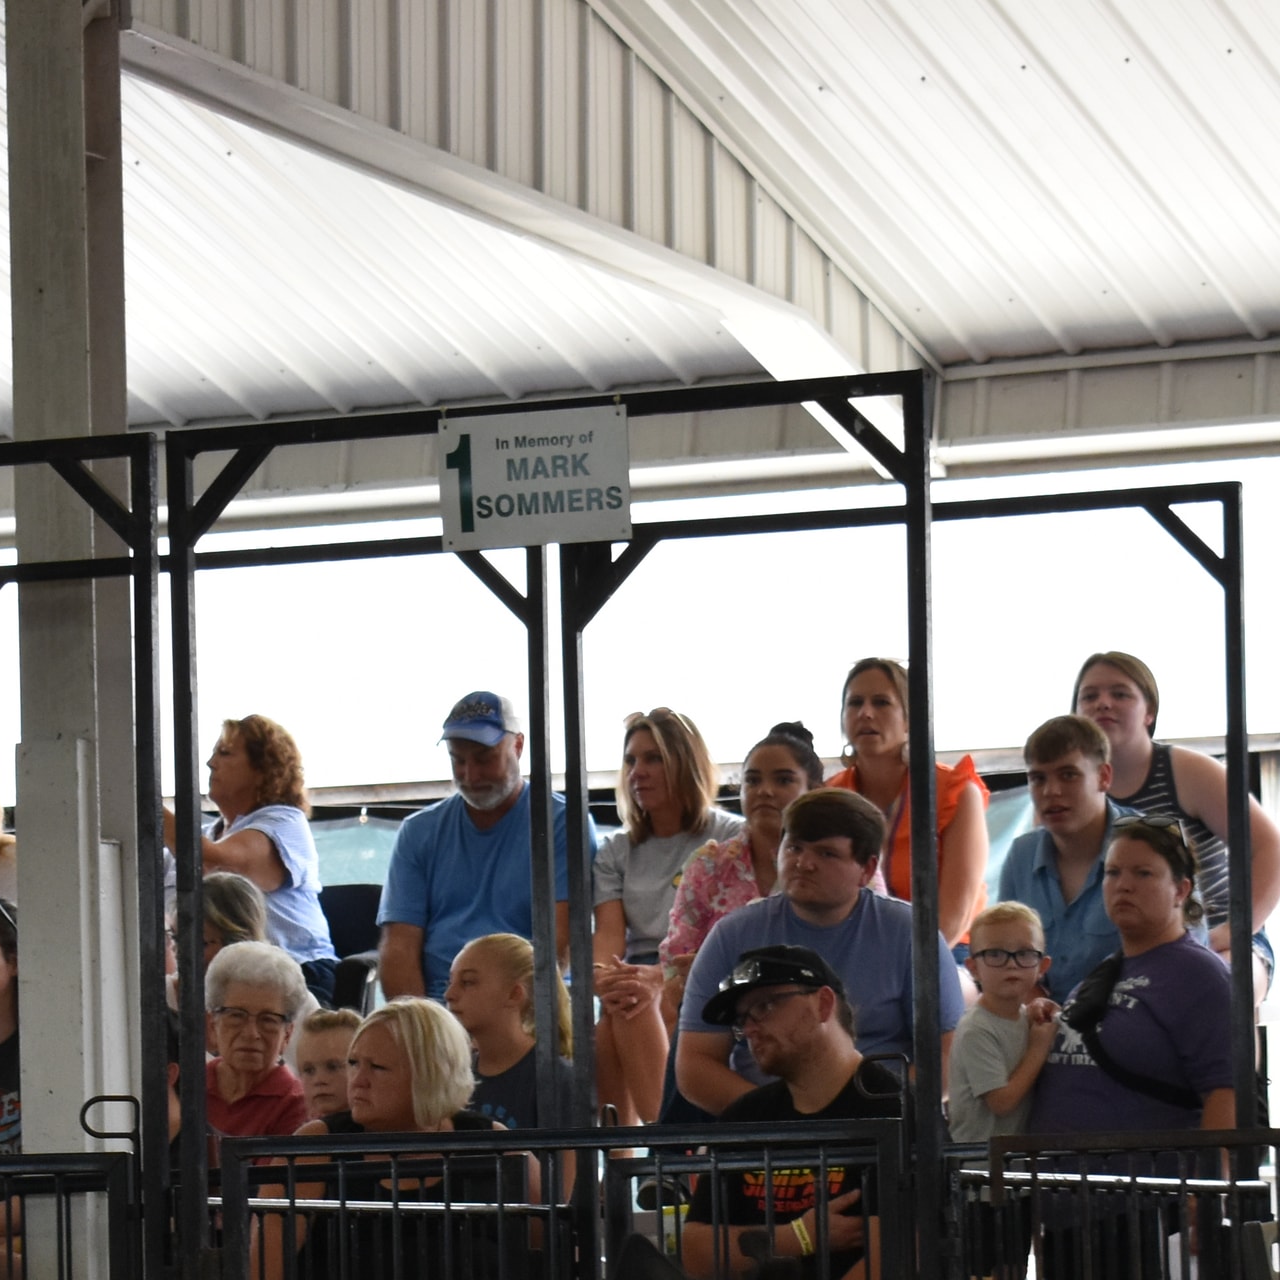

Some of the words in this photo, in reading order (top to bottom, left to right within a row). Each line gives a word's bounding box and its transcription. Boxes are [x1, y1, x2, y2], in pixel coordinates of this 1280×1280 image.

[495, 437, 509, 450] In
[514, 434, 574, 448] Memory
[579, 431, 594, 444] of
[506, 453, 591, 482] MARK
[446, 434, 475, 533] 1
[476, 486, 623, 519] SOMMERS
